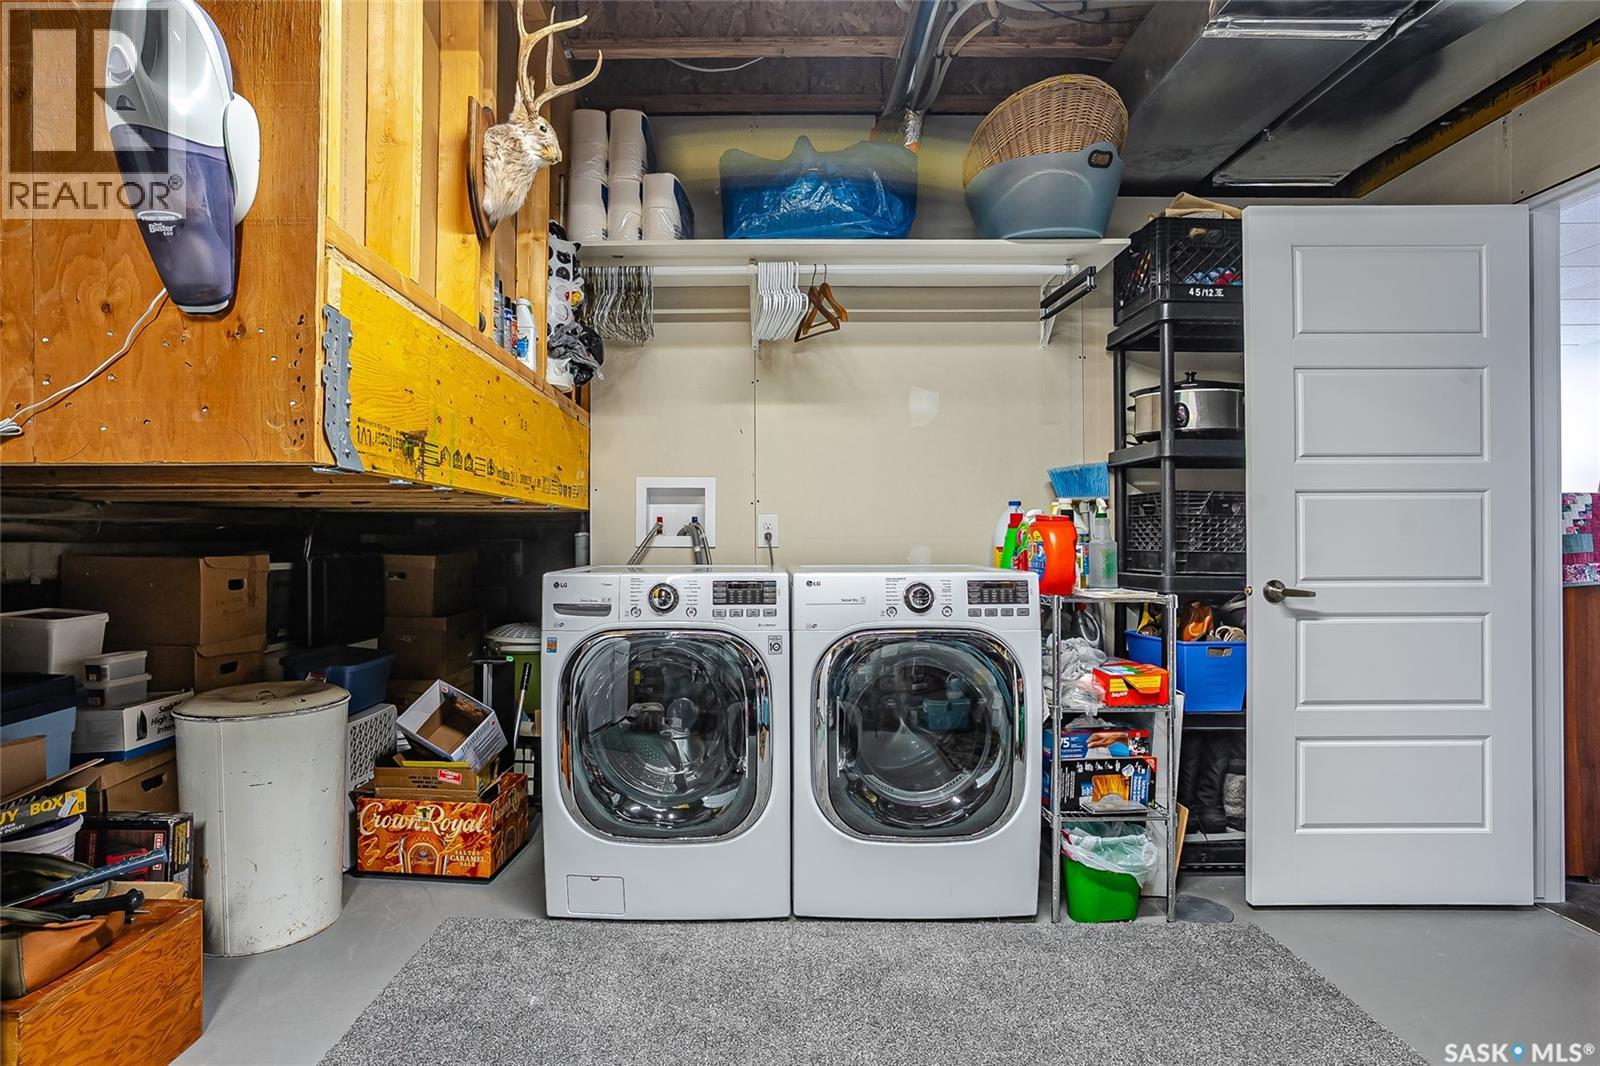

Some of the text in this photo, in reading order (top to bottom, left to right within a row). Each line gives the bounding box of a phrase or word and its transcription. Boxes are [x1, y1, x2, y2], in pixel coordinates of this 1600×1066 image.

[30, 795, 64, 817] BOX
[0, 807, 20, 827] UY
[359, 801, 488, 842] Crown Royal
[449, 855, 485, 863] CARAMEL
